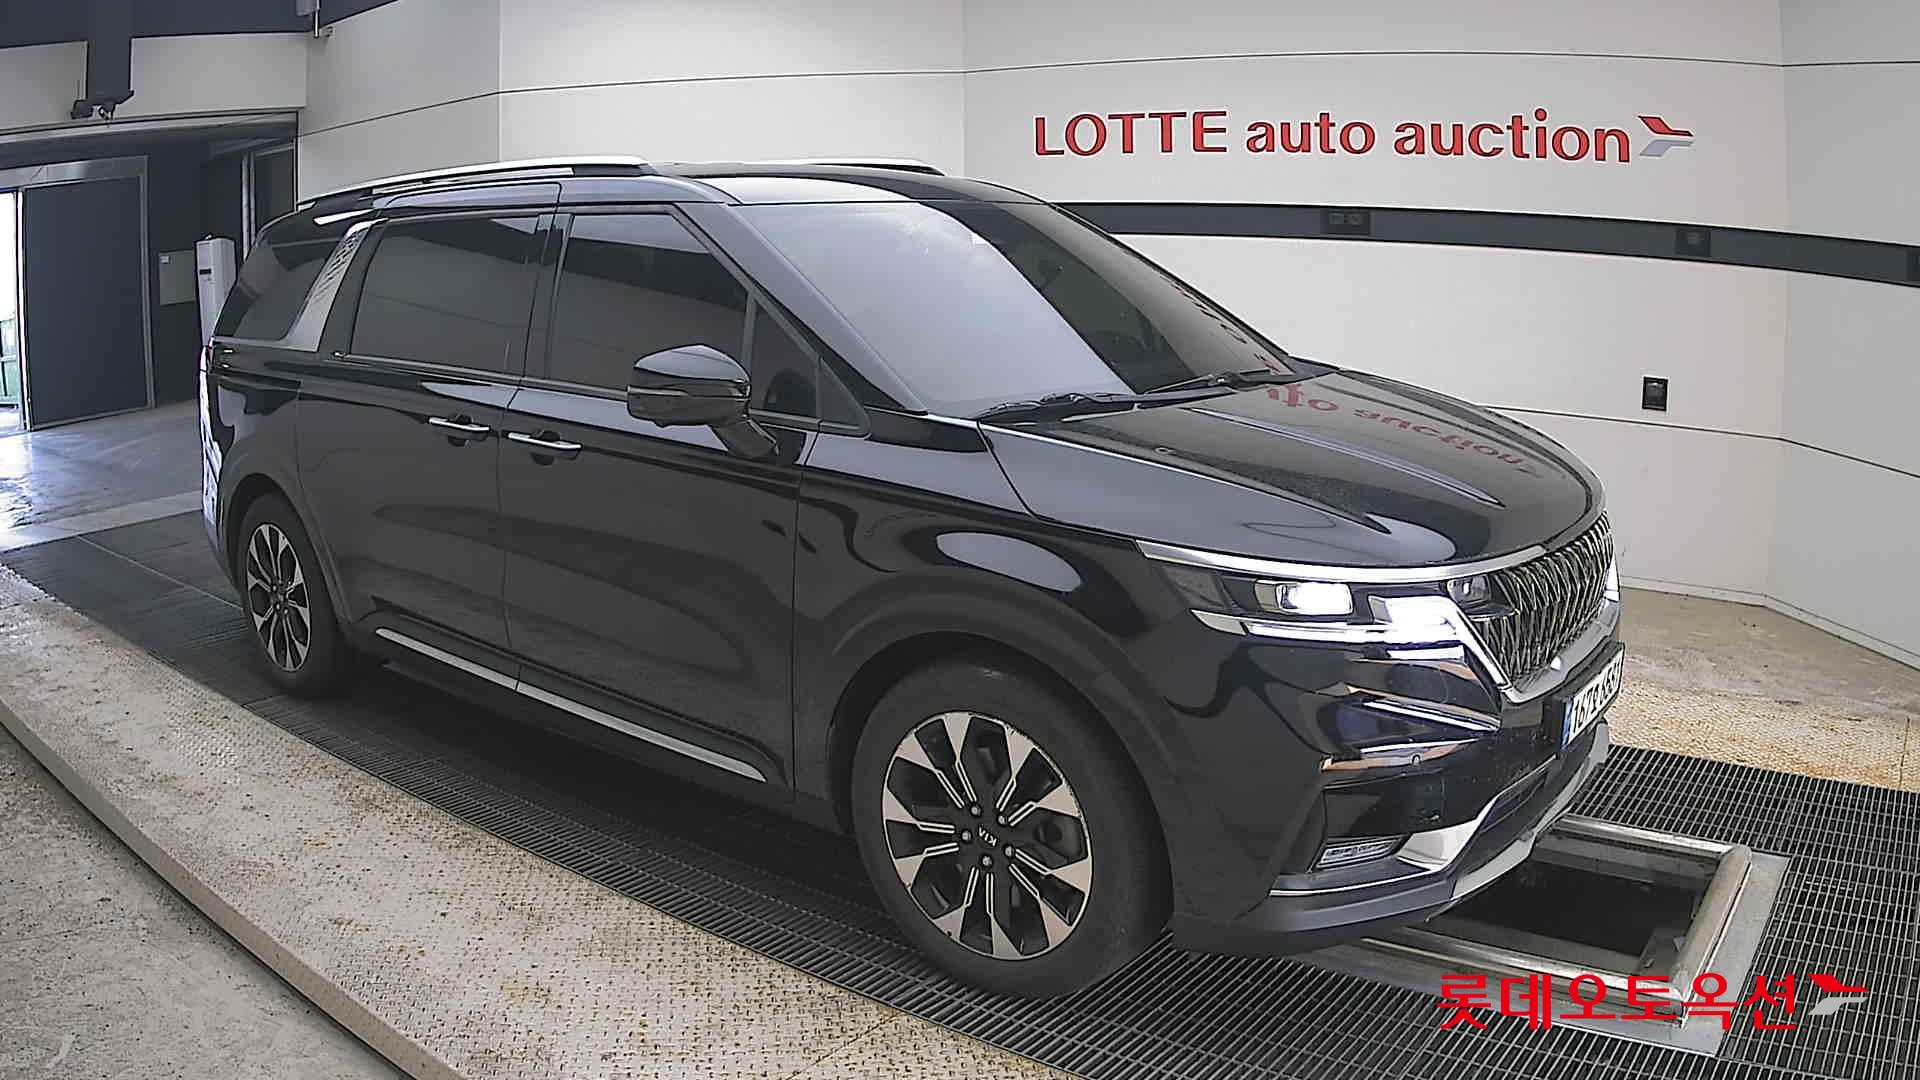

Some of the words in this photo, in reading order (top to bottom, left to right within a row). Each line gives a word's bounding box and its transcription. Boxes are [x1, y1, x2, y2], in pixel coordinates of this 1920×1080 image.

[1035, 110, 1229, 157] LOTTE
[1246, 112, 1376, 155] auto
[1394, 108, 1631, 163] auction
[978, 826, 998, 847] KIA
